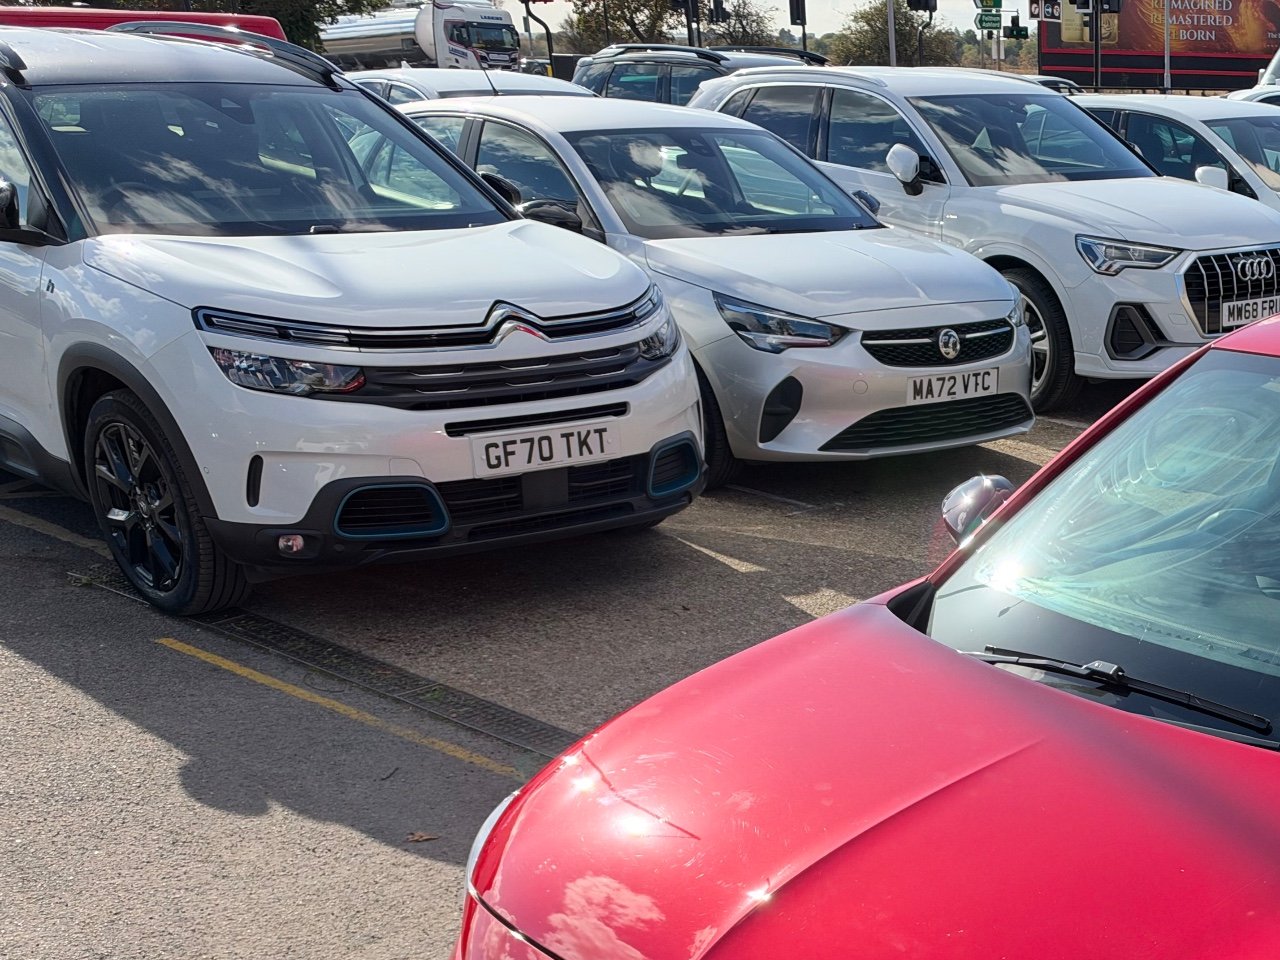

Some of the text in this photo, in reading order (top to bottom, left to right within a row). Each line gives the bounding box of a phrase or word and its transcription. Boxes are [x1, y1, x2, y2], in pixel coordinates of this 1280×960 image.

[1151, 0, 1232, 11] REMAGINED
[1227, 301, 1259, 322] MW68
[913, 371, 991, 401] MA72 VTC
[484, 427, 608, 470] GF70 TKT
